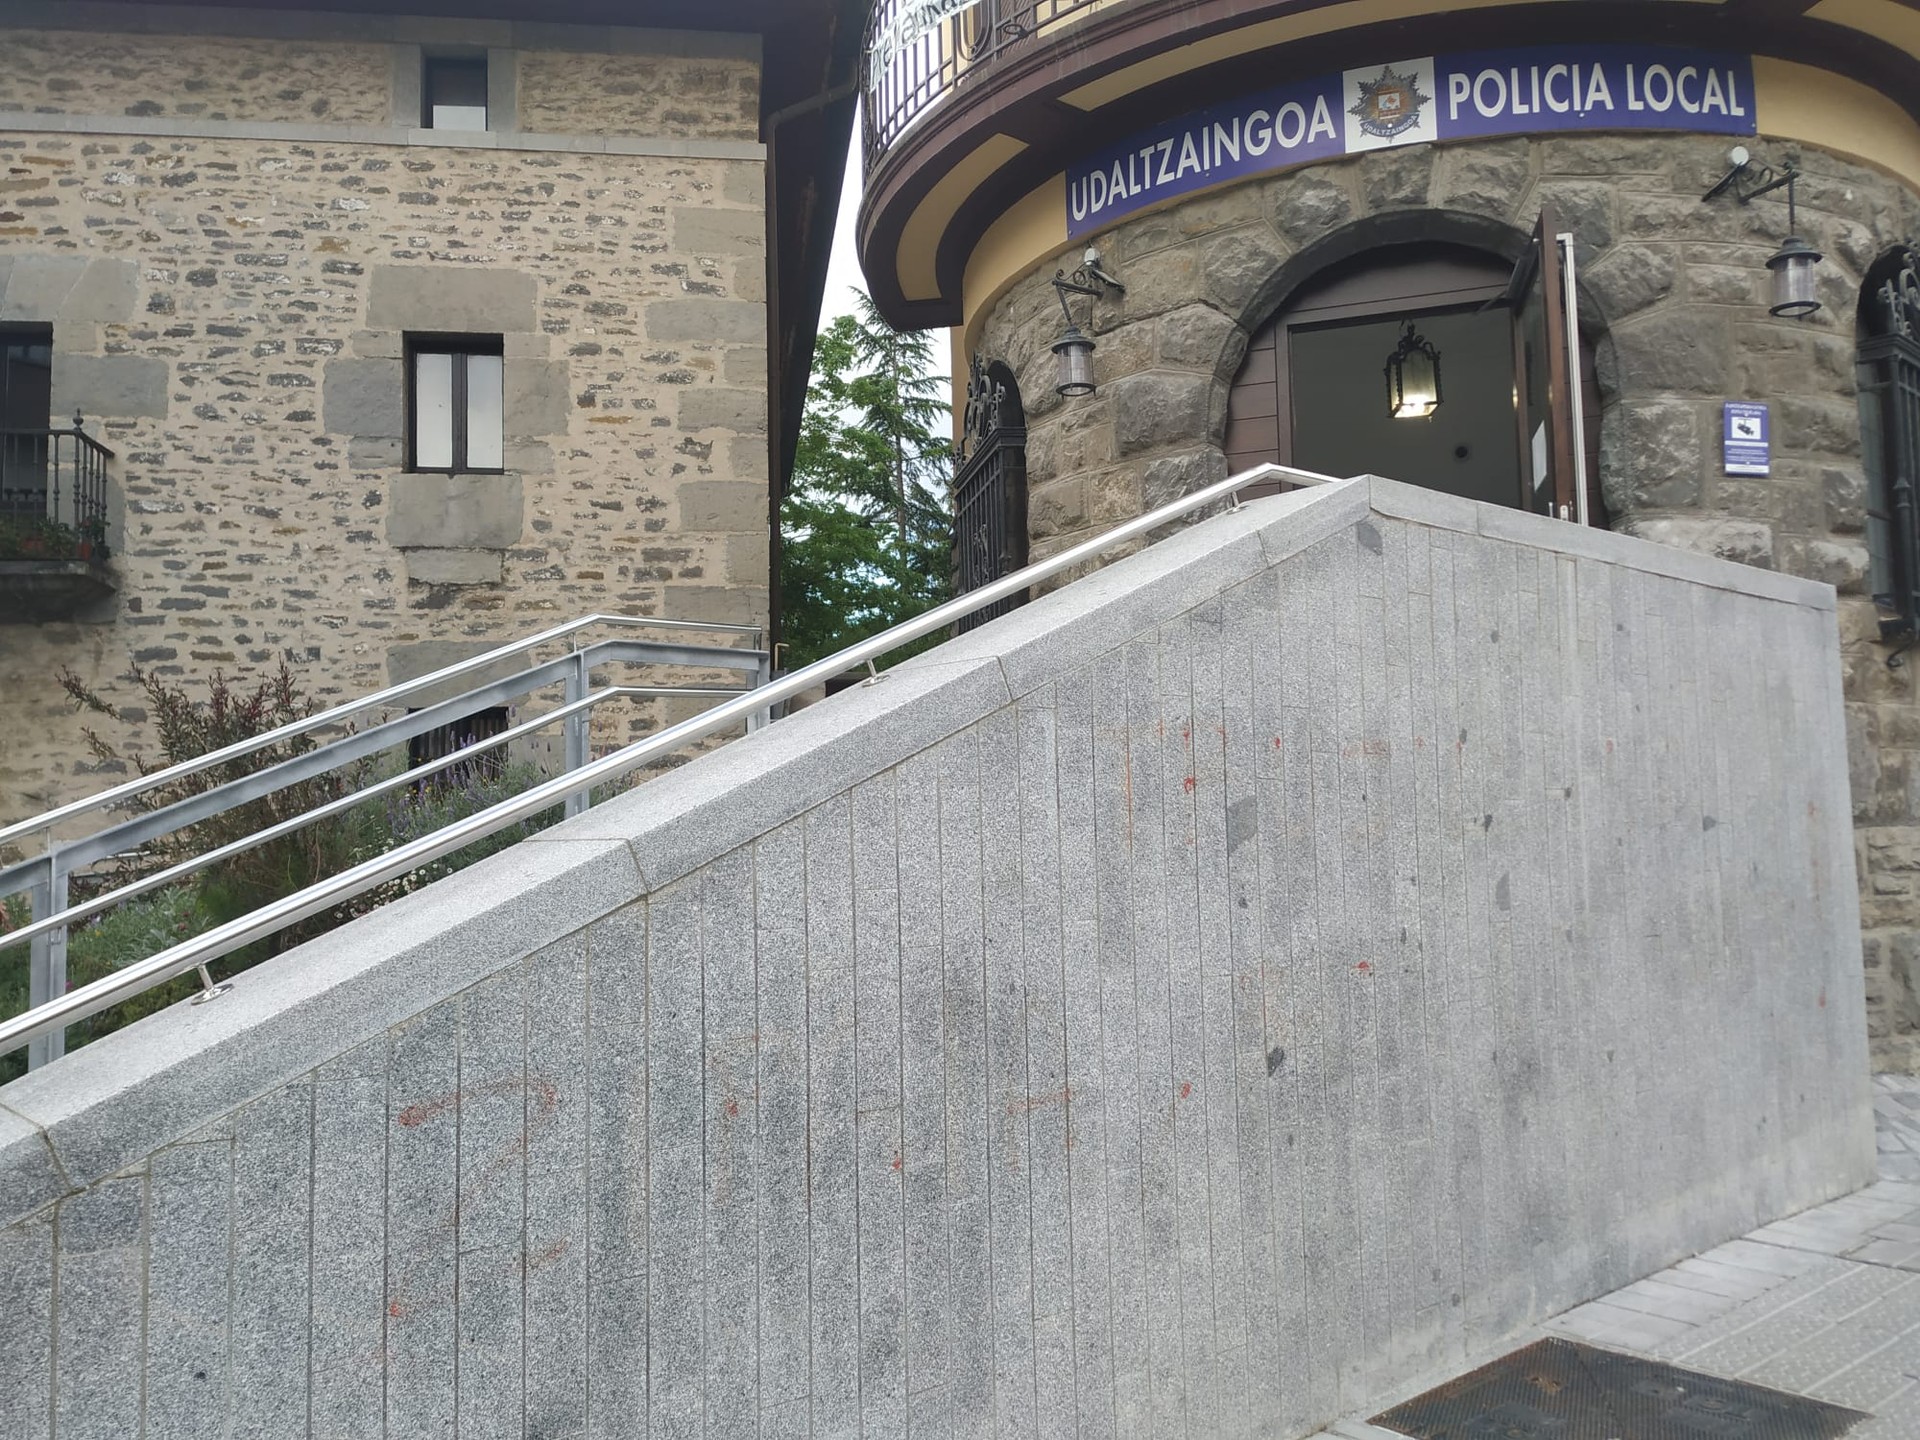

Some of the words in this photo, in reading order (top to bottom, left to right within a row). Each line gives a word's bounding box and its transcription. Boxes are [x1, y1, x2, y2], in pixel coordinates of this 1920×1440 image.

[1448, 62, 1615, 120] POLICIA
[1626, 63, 1746, 117] LOCAL
[1364, 115, 1418, 135] UDALTZAINGOA
[1070, 94, 1337, 222] UDALTZAINGOA
